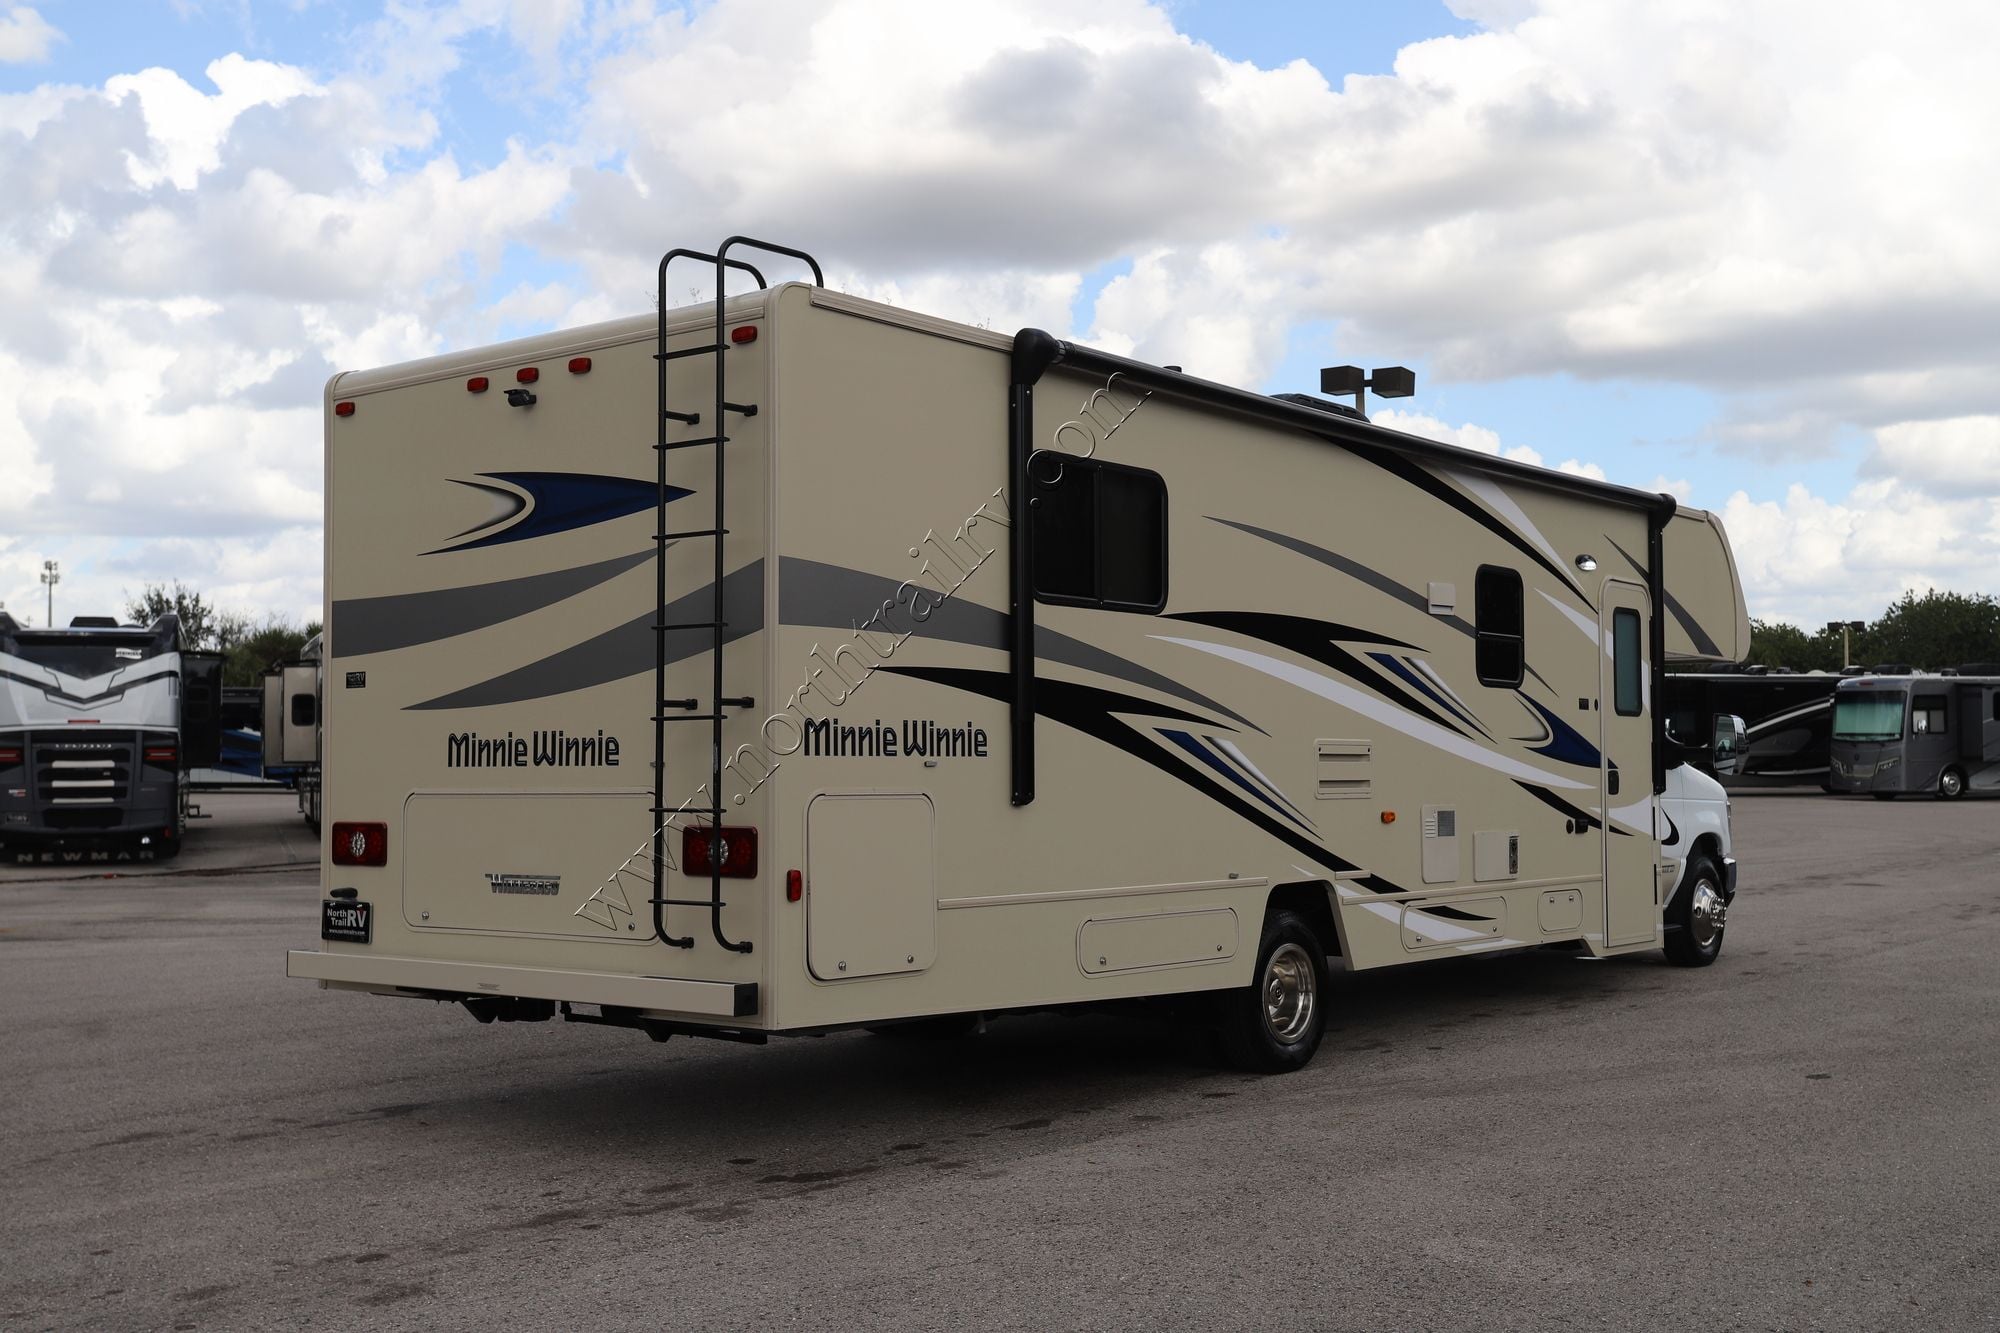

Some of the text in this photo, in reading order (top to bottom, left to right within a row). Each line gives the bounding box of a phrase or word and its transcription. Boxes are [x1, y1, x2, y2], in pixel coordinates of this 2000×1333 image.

[804, 717, 988, 757] Minnie Winnie
[448, 730, 620, 768] Minnie Winnie
[17, 850, 155, 863] NEWMAR
[327, 908, 347, 918] North
[347, 909, 367, 928] RV
[331, 917, 347, 927] Trail
